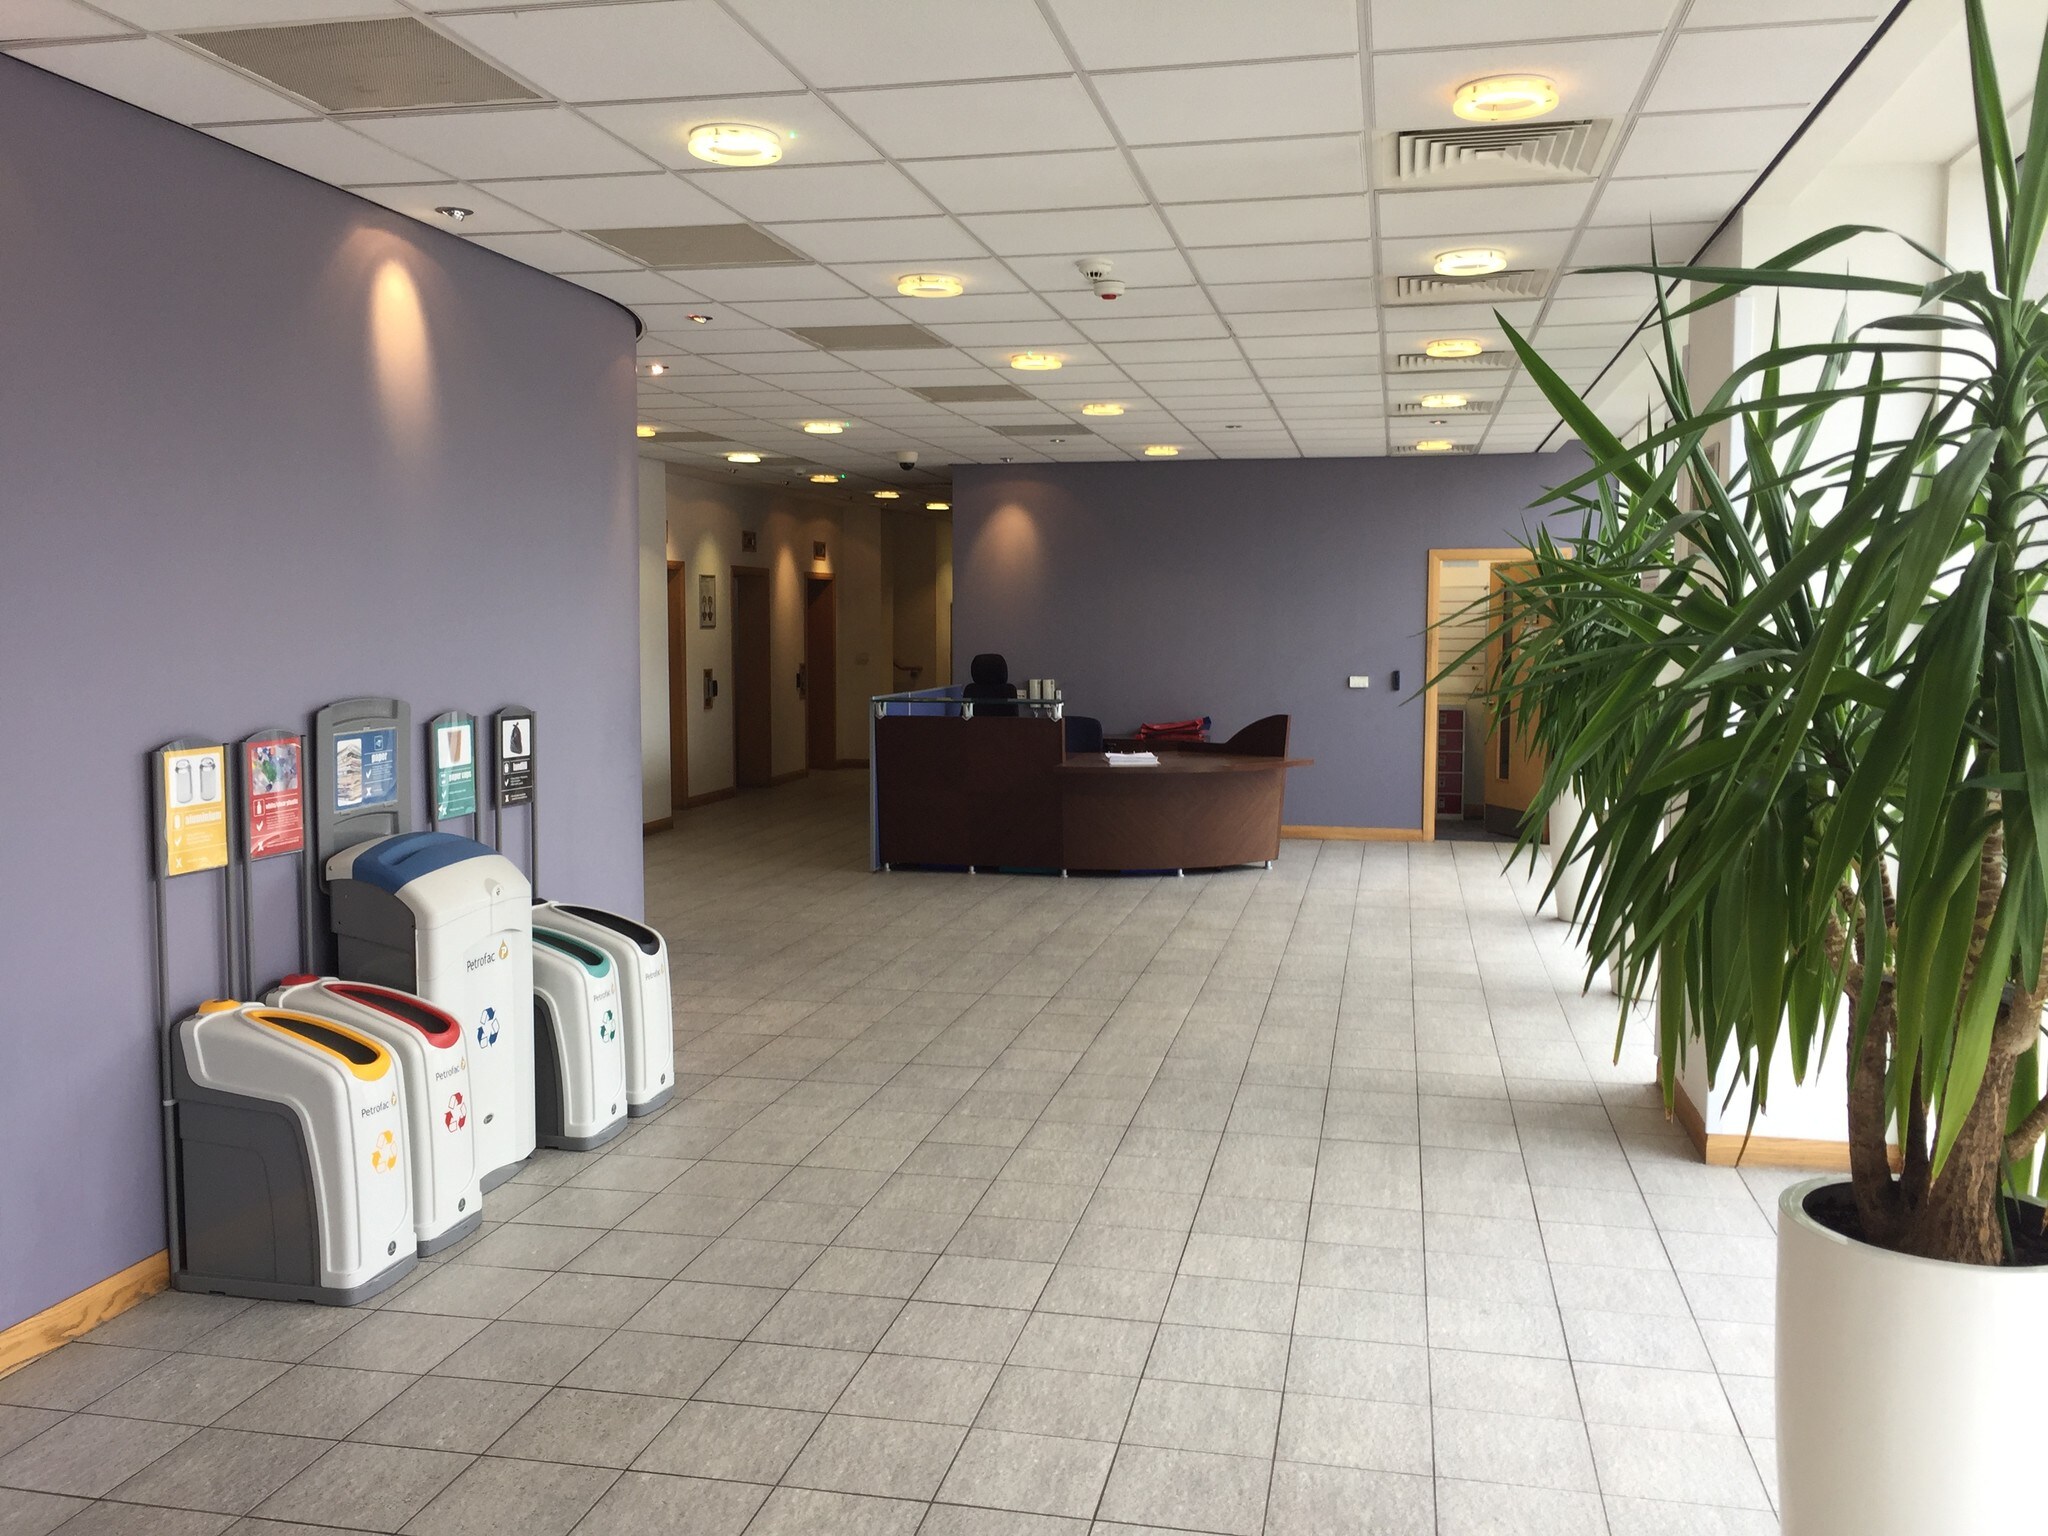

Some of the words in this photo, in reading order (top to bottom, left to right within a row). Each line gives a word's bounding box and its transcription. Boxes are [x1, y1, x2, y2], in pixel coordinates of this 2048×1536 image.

[466, 951, 496, 973] Petrofac
[435, 1065, 460, 1081] Petrofac
[361, 1101, 389, 1118] Petrofac
